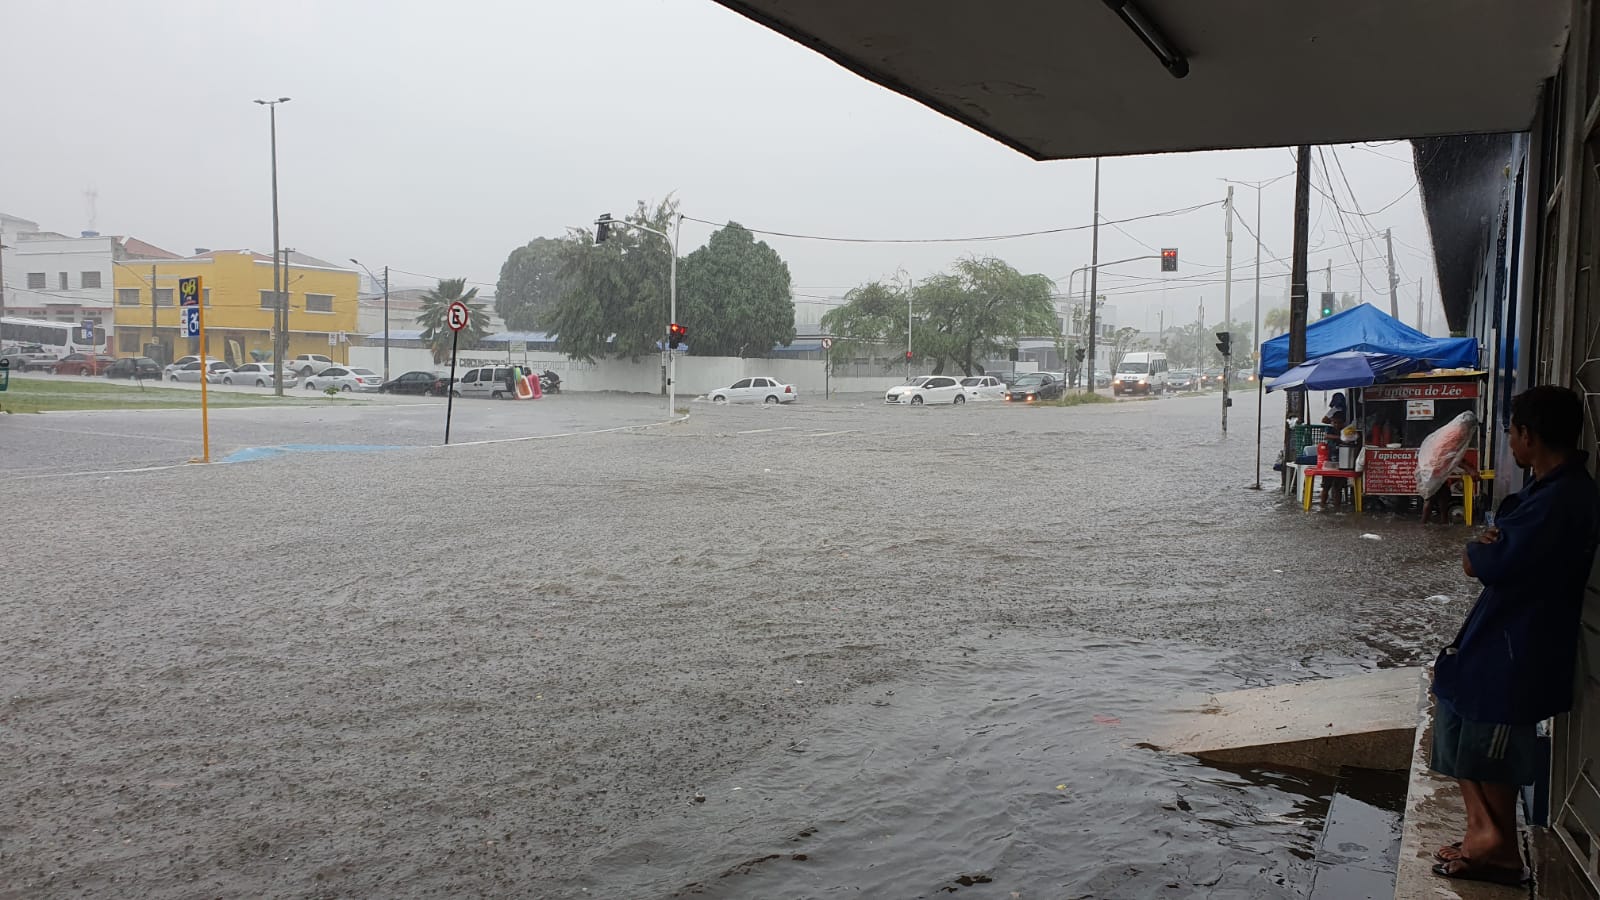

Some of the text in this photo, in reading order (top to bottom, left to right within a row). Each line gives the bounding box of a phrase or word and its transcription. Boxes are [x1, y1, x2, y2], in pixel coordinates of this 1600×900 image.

[1425, 385, 1439, 396] do
[1441, 384, 1462, 396] Léo
[1372, 450, 1412, 461] Tapiocas
